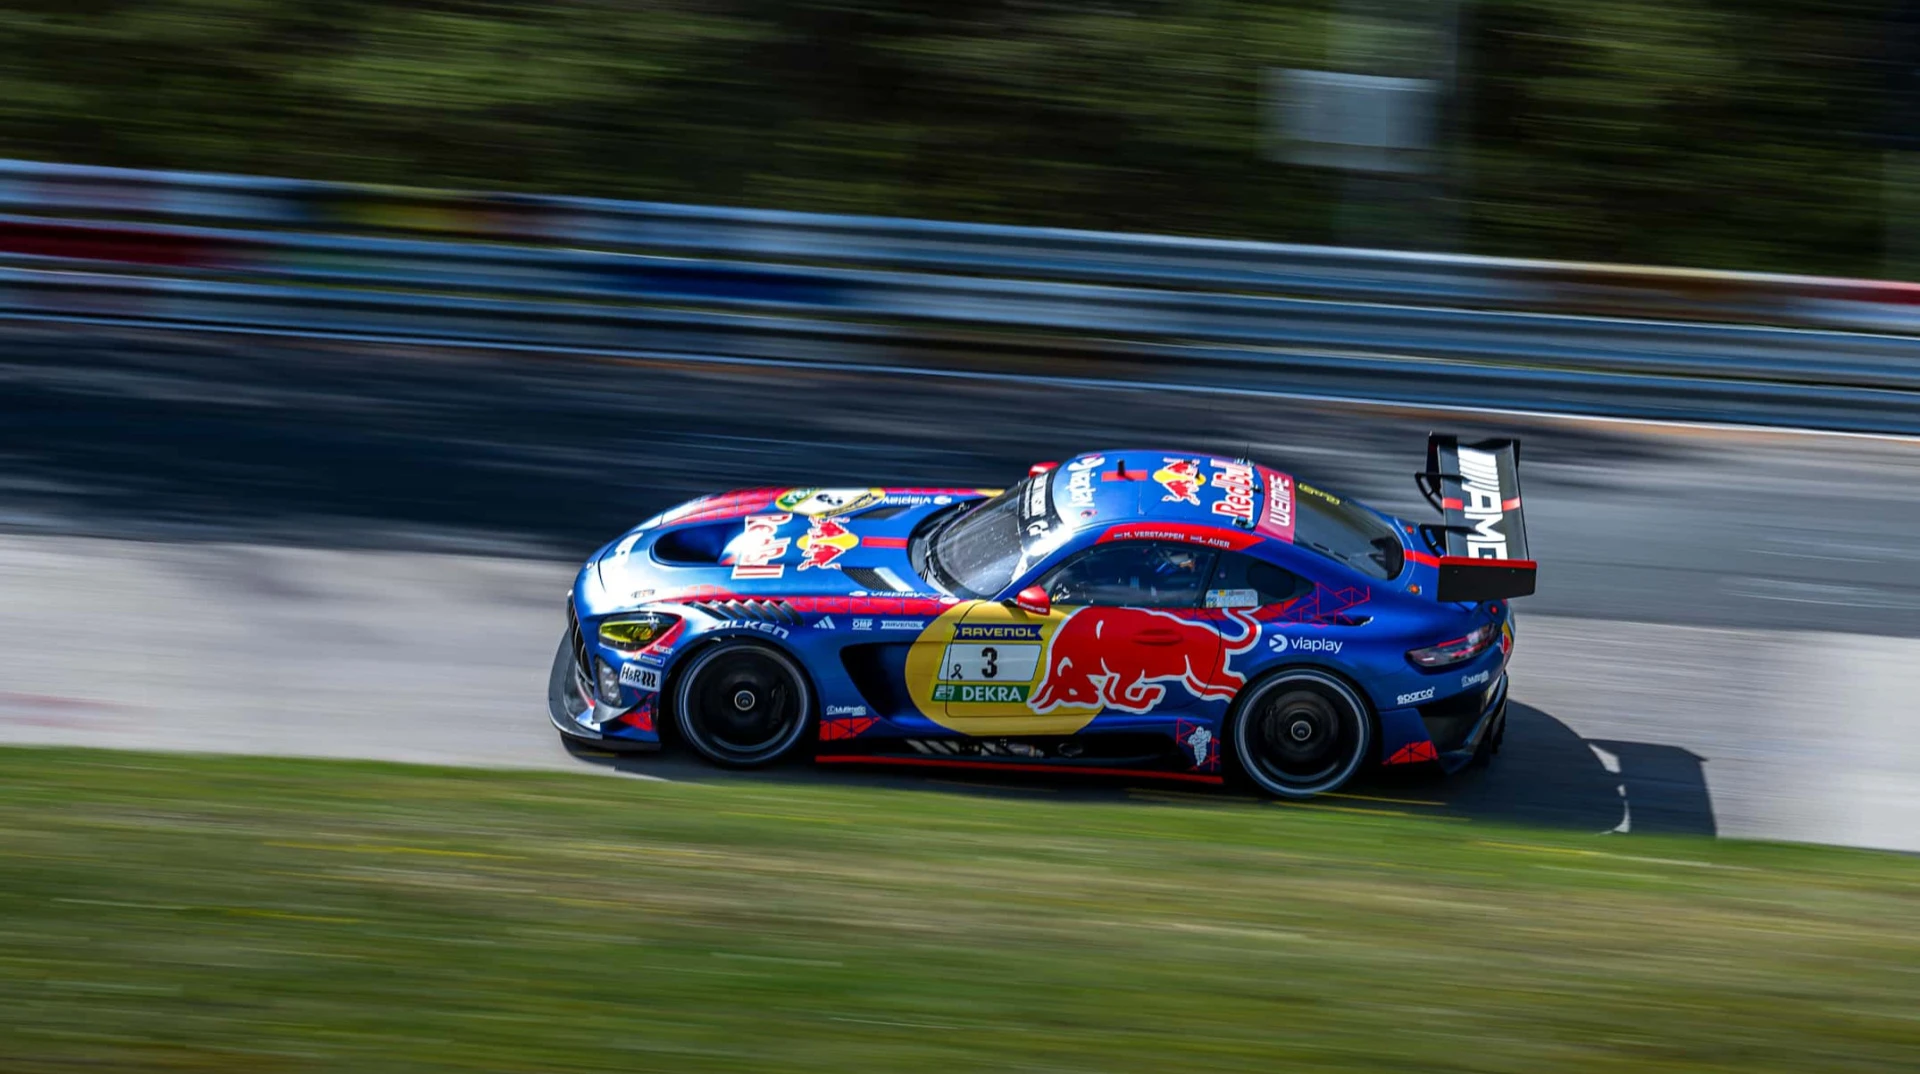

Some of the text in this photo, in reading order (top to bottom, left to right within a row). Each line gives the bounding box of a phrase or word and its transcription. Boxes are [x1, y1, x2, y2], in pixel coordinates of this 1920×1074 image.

[1211, 481, 1253, 520] Red
[1269, 474, 1291, 526] WEMPE
[1134, 531, 1184, 540] VERSTAPPEN
[1208, 538, 1230, 548] AUER
[704, 620, 789, 639] ALKEN
[852, 619, 873, 629] OMP
[962, 627, 1036, 637] RAVENOL
[1290, 637, 1343, 654] viaplay
[981, 647, 998, 678] 3
[962, 686, 1022, 701] DEKRA
[1397, 689, 1433, 705] sparco
